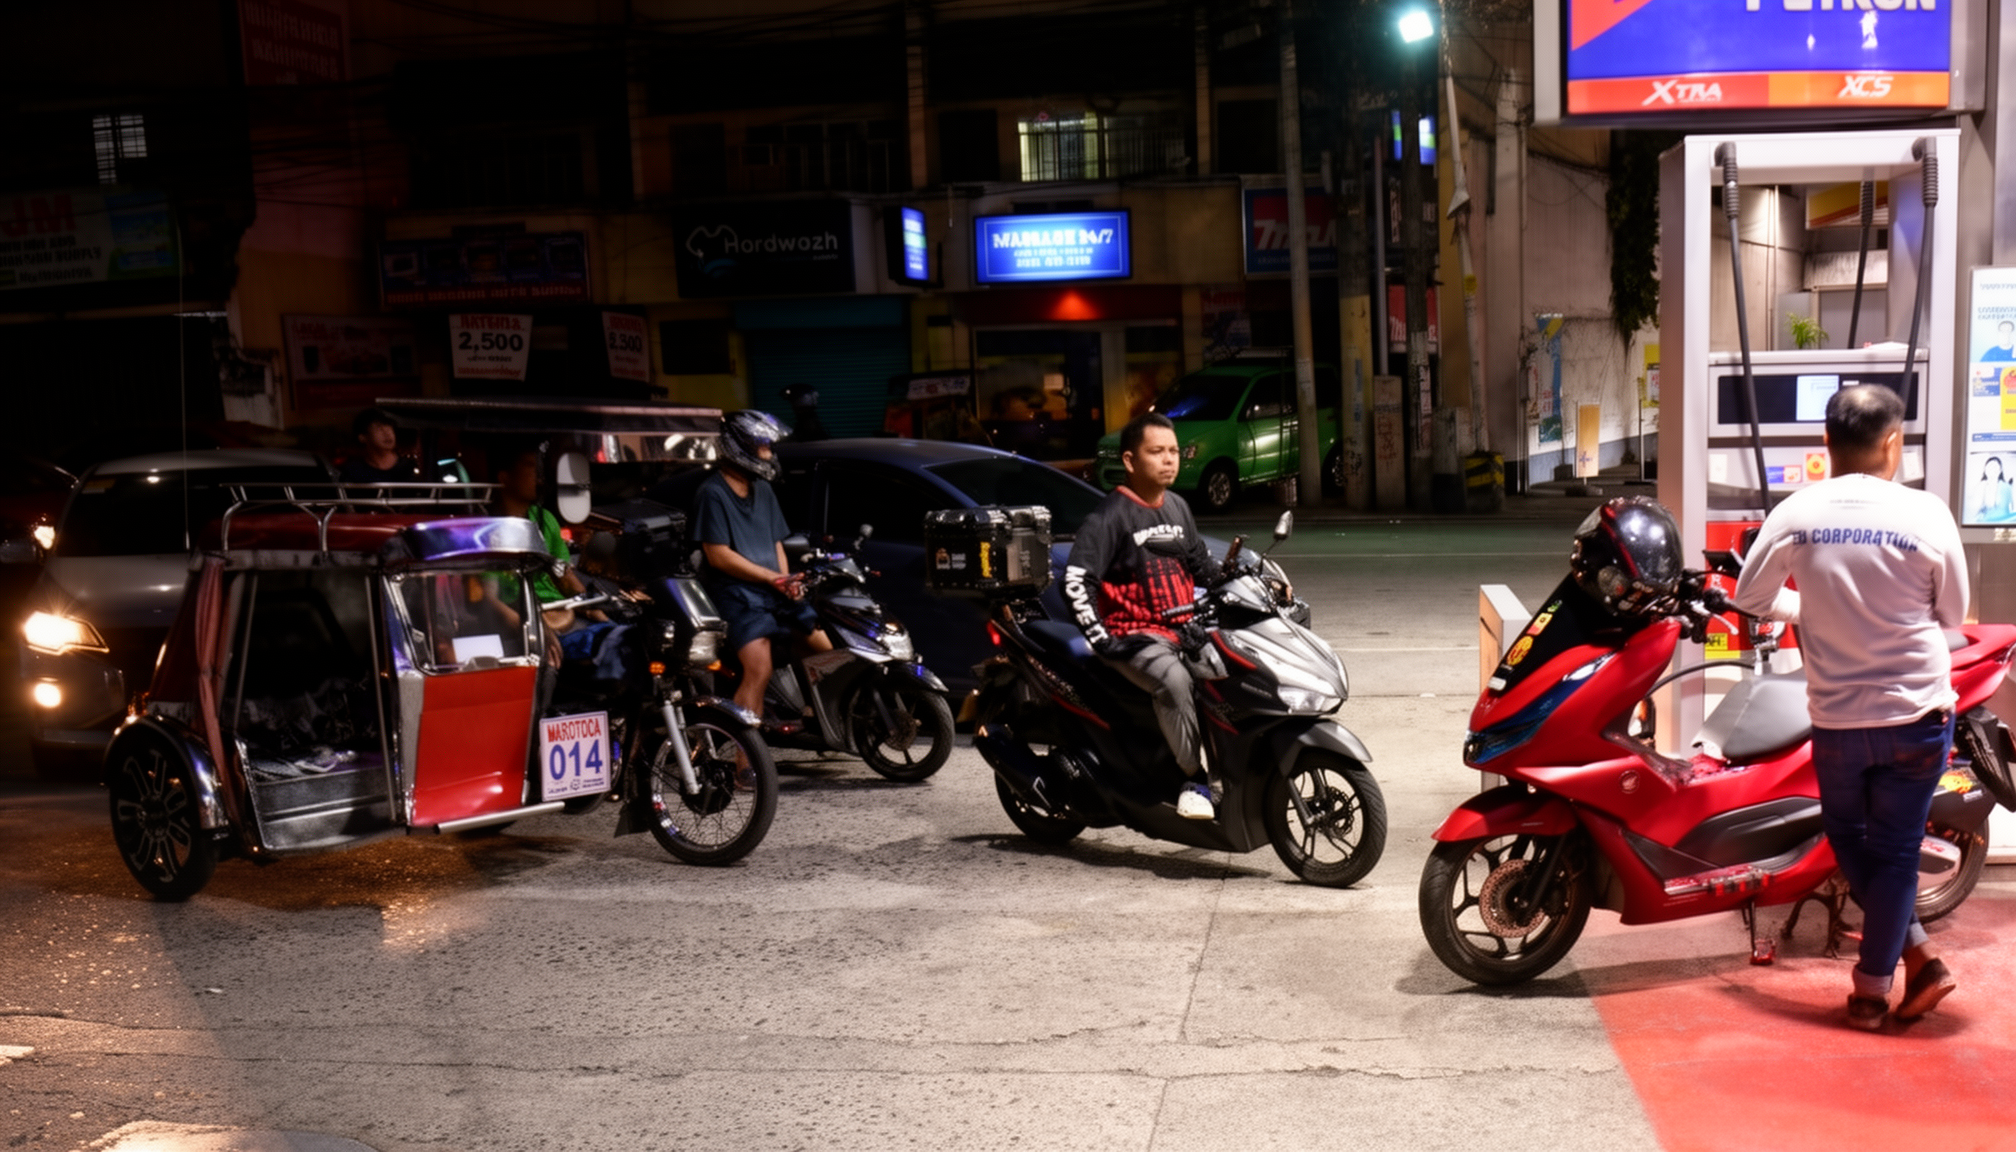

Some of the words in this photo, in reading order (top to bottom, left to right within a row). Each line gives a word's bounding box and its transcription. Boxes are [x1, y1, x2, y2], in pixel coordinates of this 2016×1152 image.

[1837, 75, 1894, 99] XCS
[458, 332, 523, 352] 2,500
[547, 718, 602, 743] MAROTOCA
[549, 739, 603, 781] 014
